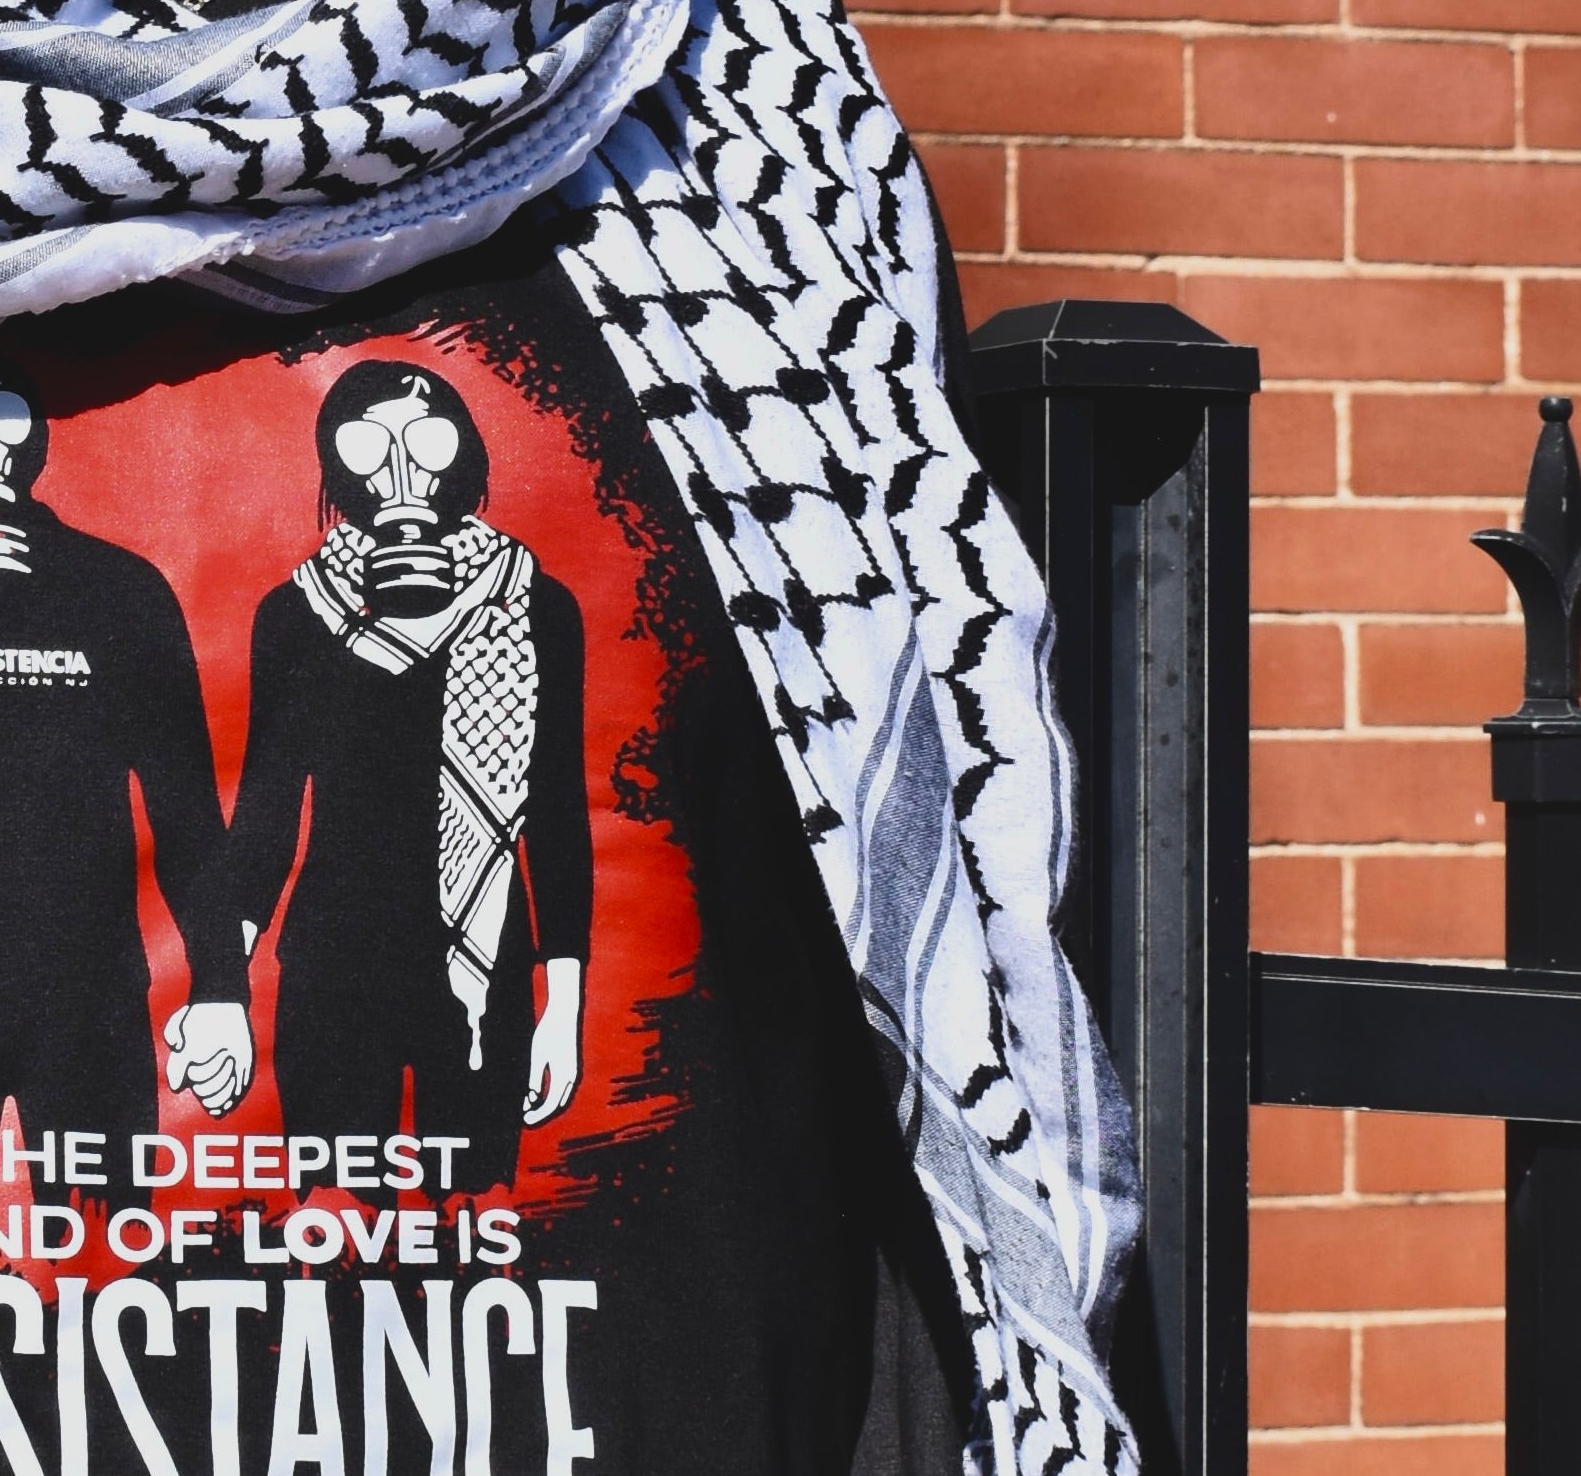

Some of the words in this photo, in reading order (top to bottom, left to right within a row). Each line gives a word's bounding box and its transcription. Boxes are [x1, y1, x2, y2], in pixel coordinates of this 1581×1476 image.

[132, 1134, 470, 1190] DEEPEST
[107, 1208, 218, 1264] OF
[243, 1209, 439, 1265] LOVE
[458, 1209, 522, 1265] IS
